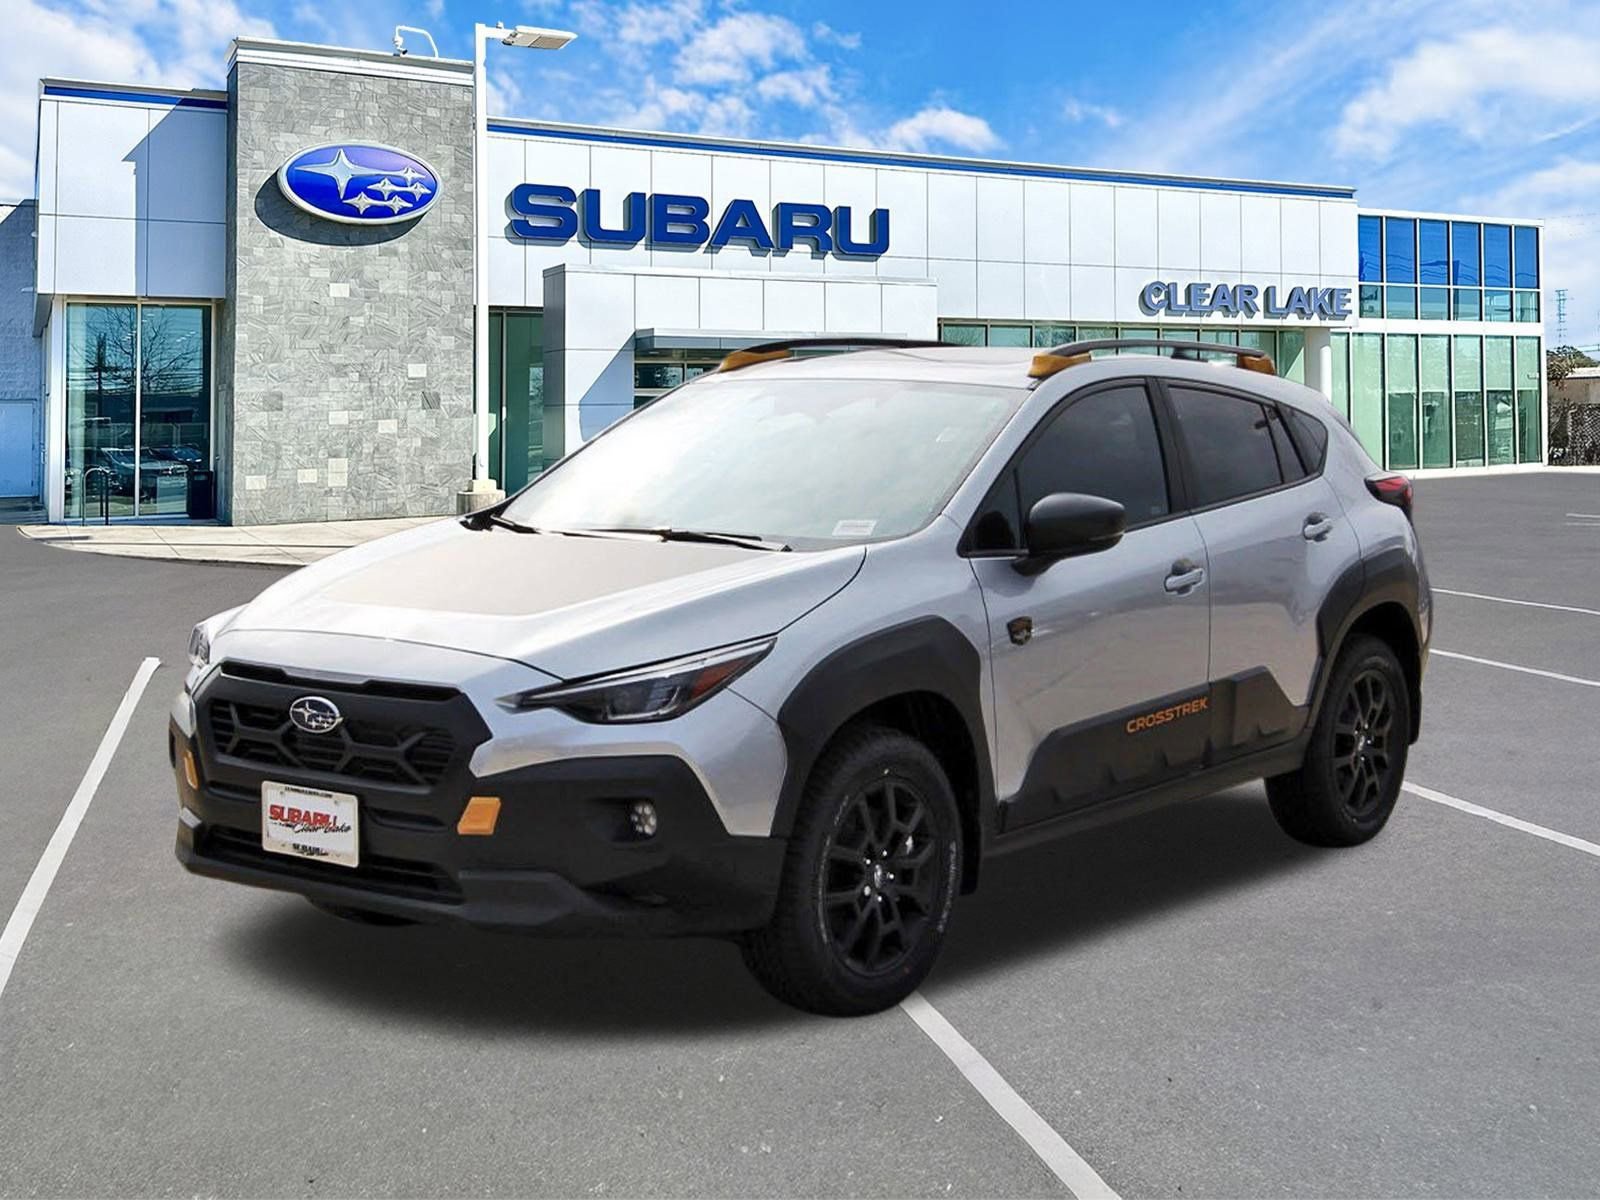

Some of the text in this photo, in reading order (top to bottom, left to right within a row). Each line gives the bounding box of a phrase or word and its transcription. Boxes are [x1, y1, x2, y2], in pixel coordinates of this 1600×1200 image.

[505, 183, 890, 260] SUBARU
[1140, 281, 1353, 320] CLEAR LAKE
[1126, 697, 1209, 734] CROSSTREK
